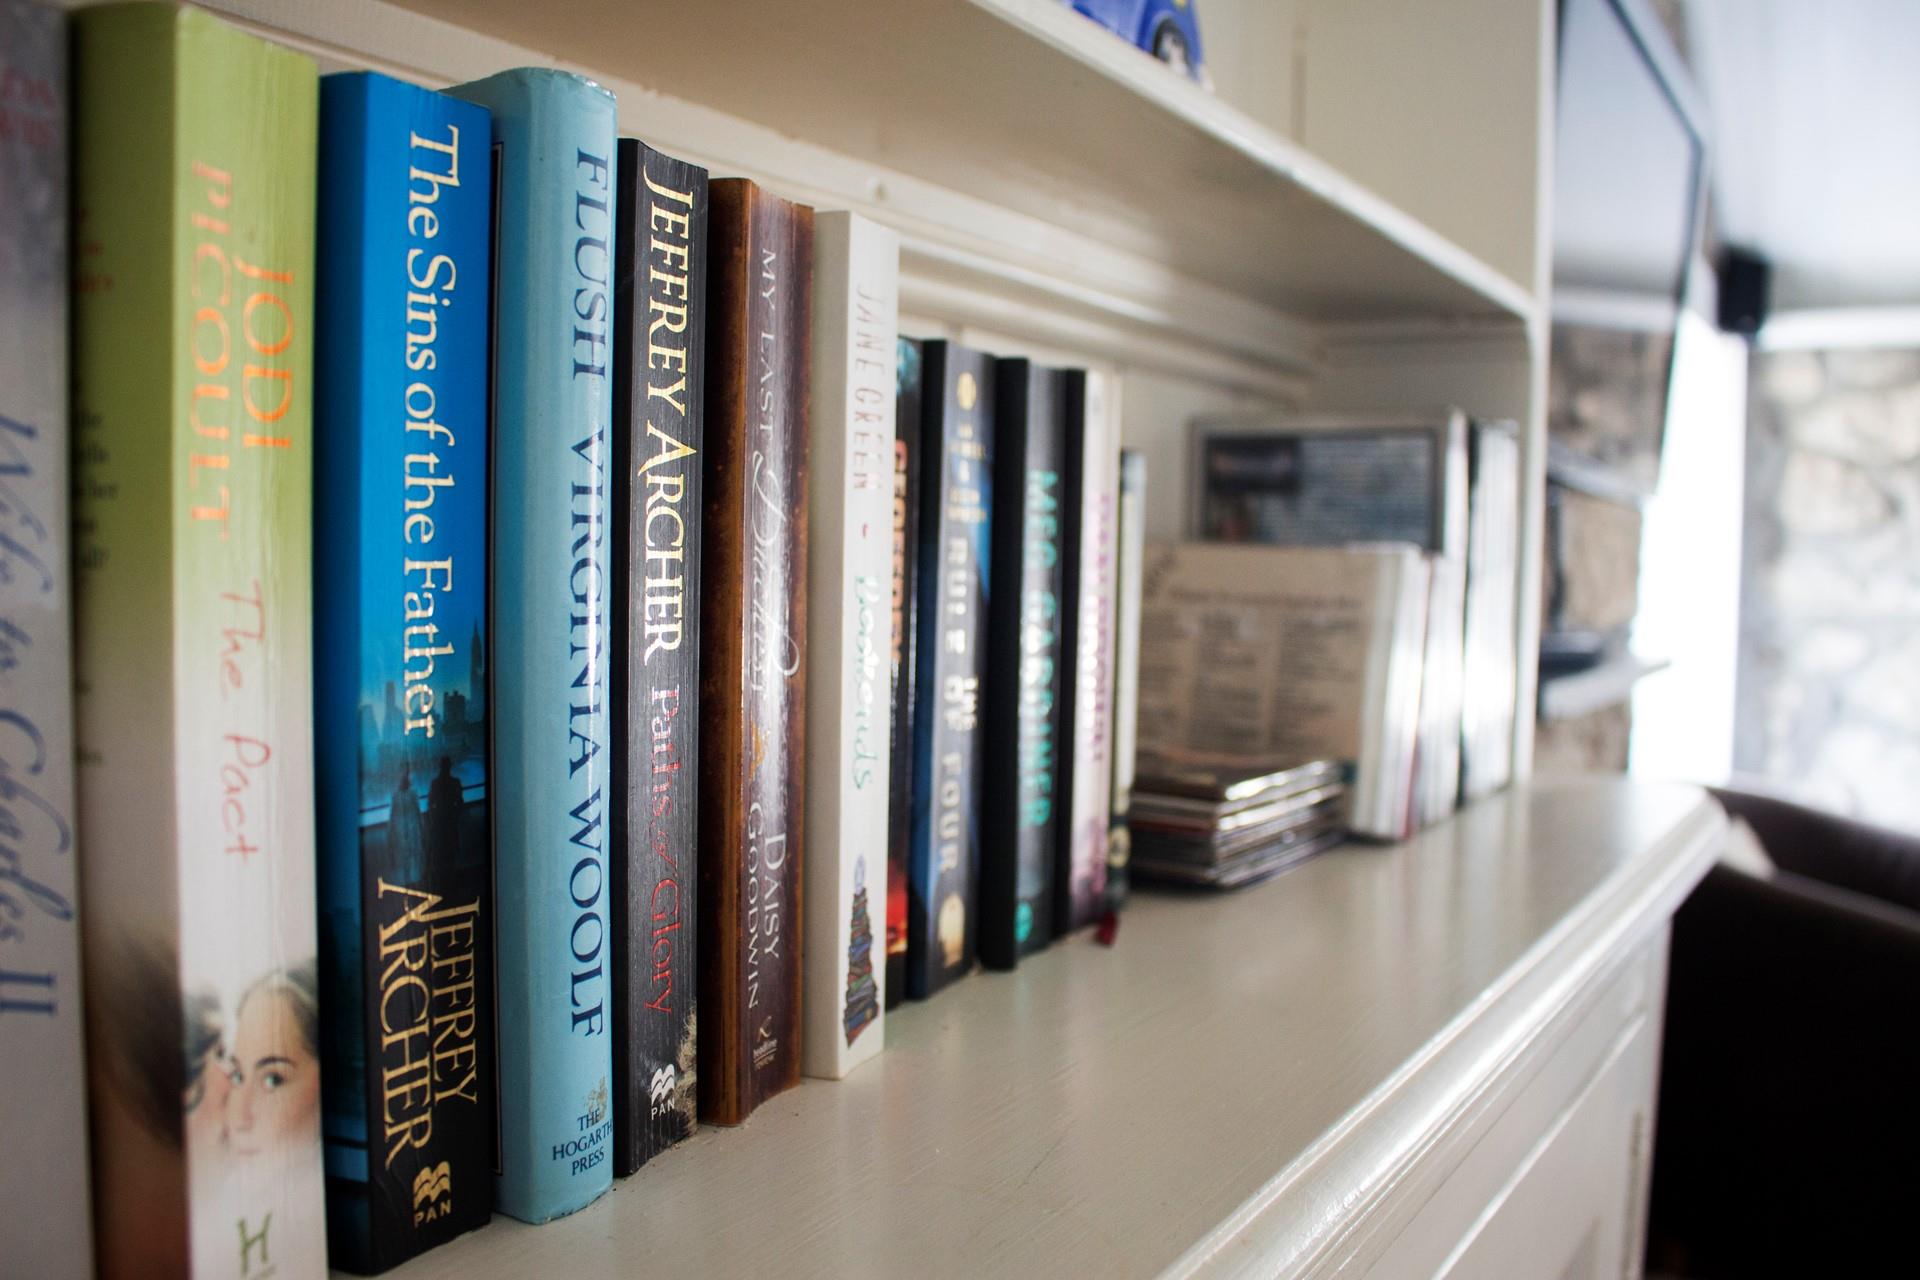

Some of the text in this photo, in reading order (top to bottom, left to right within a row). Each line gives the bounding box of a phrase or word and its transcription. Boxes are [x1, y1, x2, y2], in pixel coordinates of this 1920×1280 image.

[191, 160, 234, 542] PICOULT
[234, 255, 294, 450] JODI
[760, 248, 777, 315] MY
[404, 124, 462, 739] The Sins of the Father
[637, 162, 698, 667] JEFFREY ARCHER
[758, 331, 775, 437] LAST
[852, 284, 888, 491] JANE GREEN
[568, 146, 609, 1038] FLUSH VIRGINIA WOOLF
[220, 580, 271, 865] The Pact
[650, 683, 682, 819] Paths
[938, 752, 963, 873] FOUR
[644, 872, 682, 1015] Glory
[748, 801, 764, 1010] GOODWIN
[763, 833, 787, 960] DAISY
[376, 876, 443, 1171] ARCHER
[418, 896, 480, 1106] JEFFREY
[552, 1121, 613, 1161] HOGARTH
[571, 1147, 604, 1176] PRESS
[577, 1109, 602, 1130] THE
[651, 1098, 676, 1121] PAN
[413, 1199, 453, 1230] PAN
